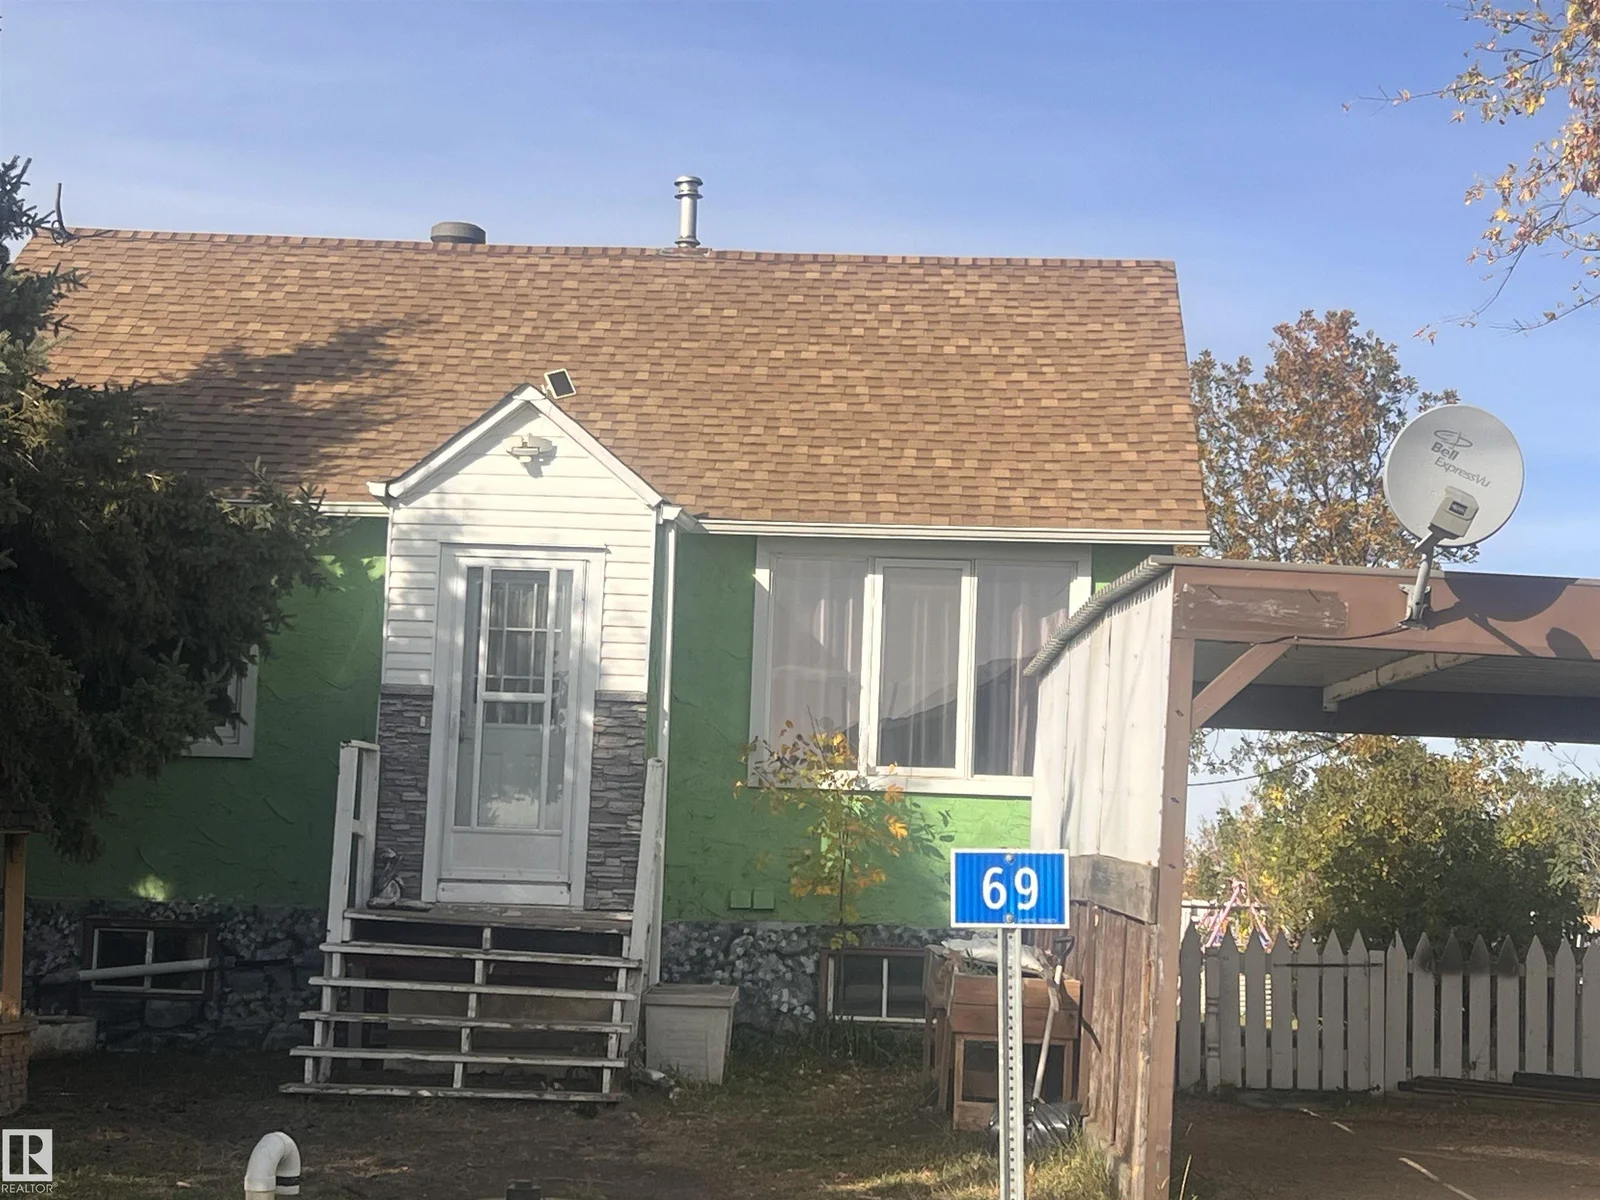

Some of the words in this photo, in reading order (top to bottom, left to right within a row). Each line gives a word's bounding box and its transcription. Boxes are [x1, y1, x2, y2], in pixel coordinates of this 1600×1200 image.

[1431, 441, 1460, 461] Bell
[1434, 456, 1491, 488] ExpressVu
[982, 866, 1039, 911] 69
